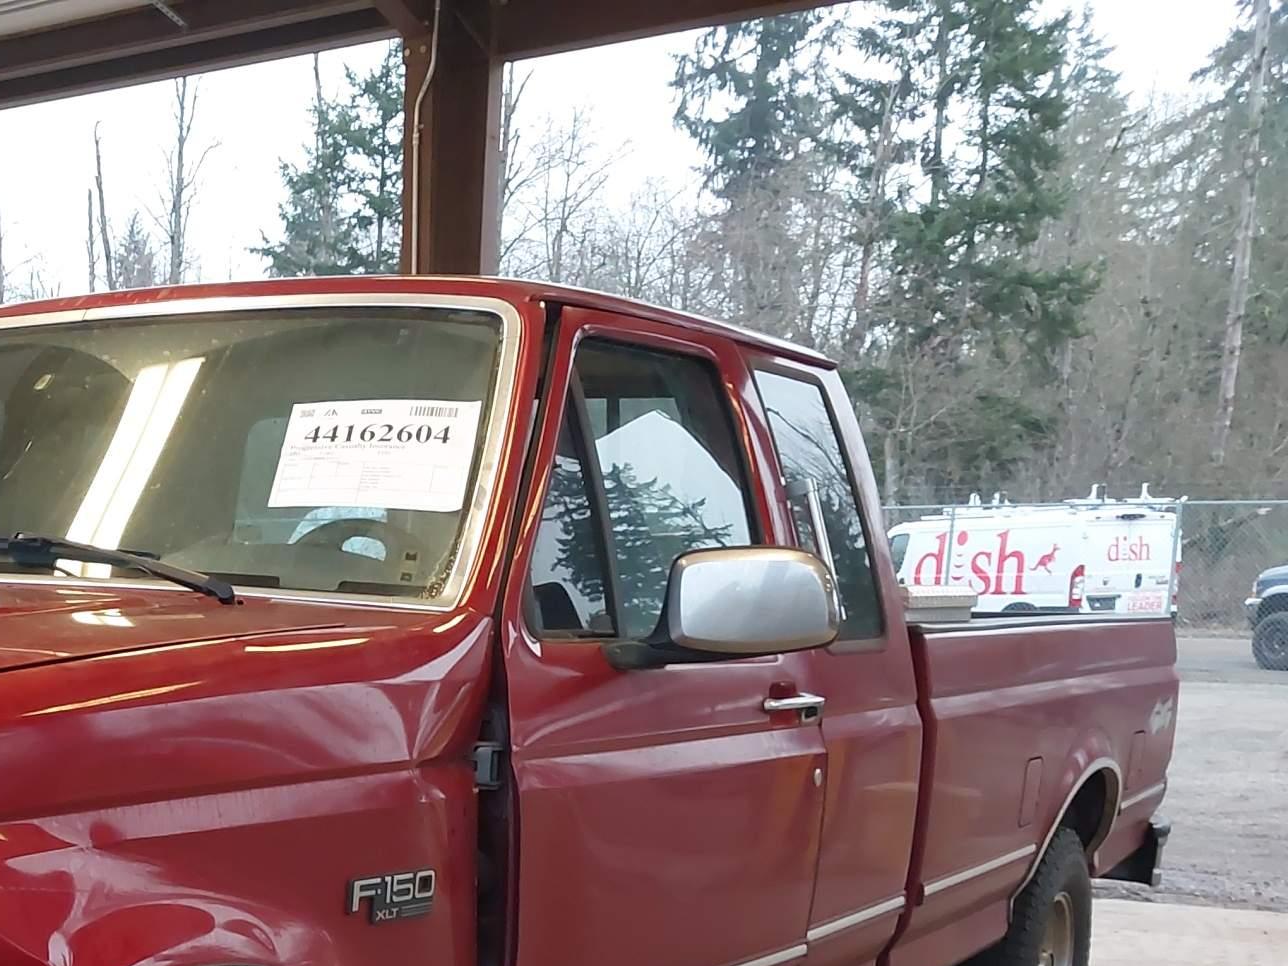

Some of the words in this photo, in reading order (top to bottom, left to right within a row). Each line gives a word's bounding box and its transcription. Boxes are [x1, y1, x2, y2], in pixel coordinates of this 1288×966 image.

[304, 424, 451, 444] 44162604
[1107, 536, 1151, 562] dish
[914, 529, 1028, 596] dish
[376, 907, 399, 920] XLT
